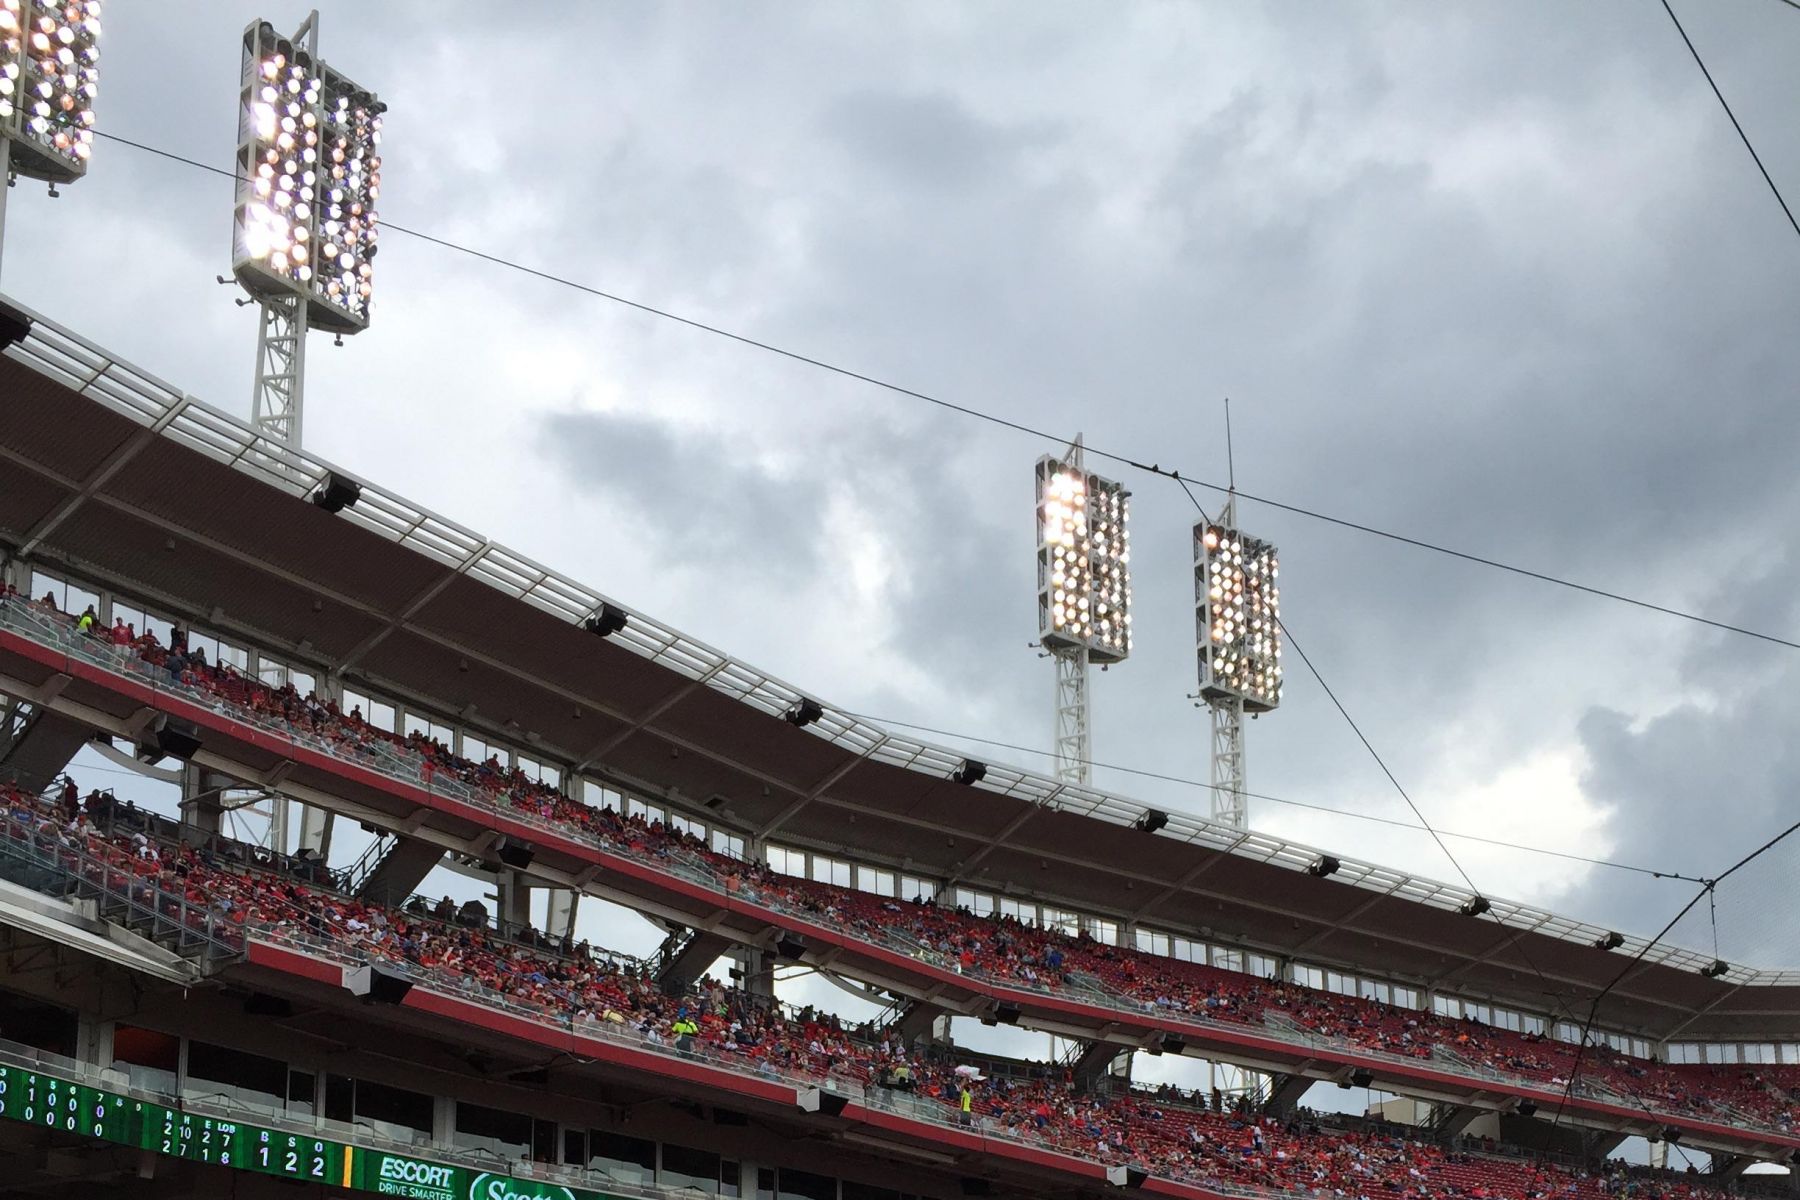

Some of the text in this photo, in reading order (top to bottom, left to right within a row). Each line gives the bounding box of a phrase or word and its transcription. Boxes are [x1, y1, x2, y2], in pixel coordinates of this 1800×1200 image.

[29, 1075, 35, 1084] 4
[50, 1081, 56, 1090] 5
[69, 1086, 77, 1095] 6
[97, 1093, 104, 1102] 7
[29, 1088, 34, 1101] 1
[48, 1093, 56, 1106] 0
[69, 1098, 77, 1111] 0
[96, 1105, 104, 1118] 0
[25, 1107, 33, 1120] 0
[46, 1112, 54, 1125] 0
[67, 1117, 75, 1130] 0
[94, 1123, 102, 1136] 0
[166, 1111, 236, 1134] R H E LOB
[164, 1123, 230, 1147] 2 10 2 7
[261, 1131, 269, 1142] B
[288, 1136, 296, 1147] S
[162, 1140, 230, 1165] 2 7 1 8
[260, 1147, 324, 1176] 1 2 2
[380, 1157, 454, 1188] ESCORT
[379, 1181, 407, 1198] DRIVE
